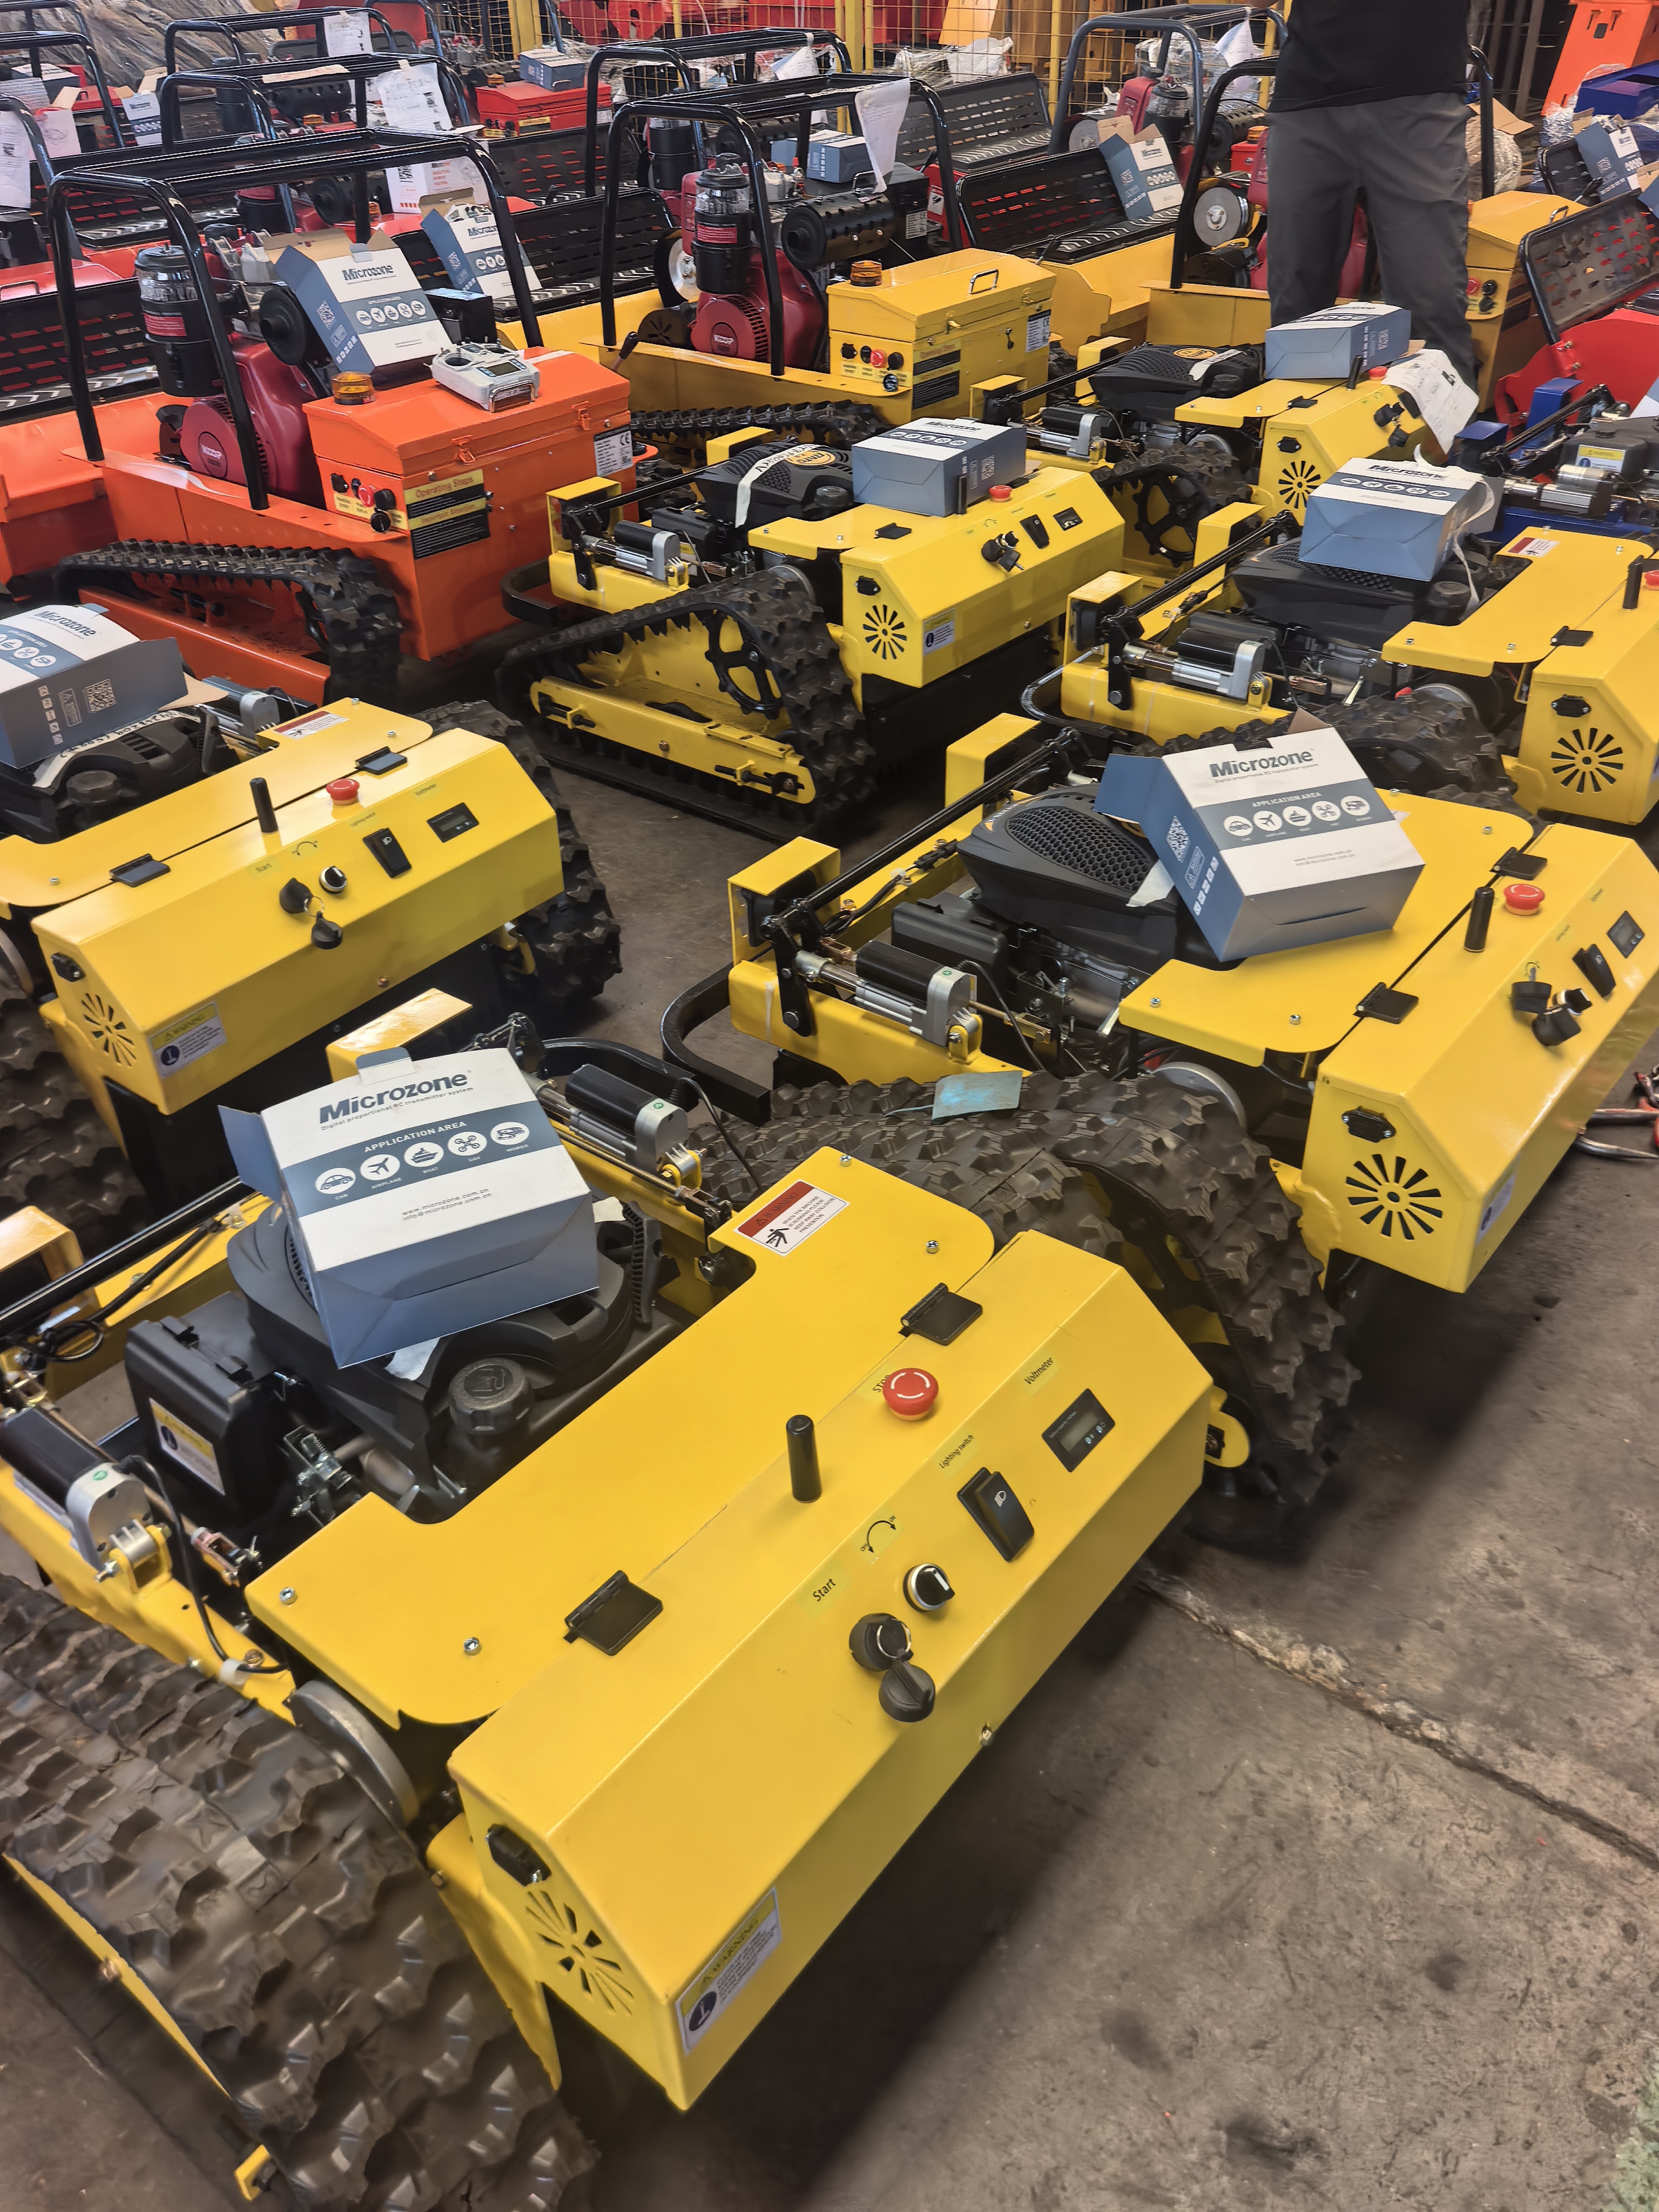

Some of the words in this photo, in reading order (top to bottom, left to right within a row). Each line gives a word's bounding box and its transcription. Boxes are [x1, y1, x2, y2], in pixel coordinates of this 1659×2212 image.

[33, 611, 97, 636] Microzone
[1209, 751, 1313, 777] Microzone
[1252, 795, 1301, 807] APPLICATION
[1300, 792, 1323, 800] AREA
[320, 1074, 468, 1124] Microzone
[321, 1120, 346, 1131] Digital
[347, 1105, 393, 1123] proportional
[404, 1092, 447, 1105] transmitter
[448, 1087, 474, 1096] system
[364, 1128, 436, 1153] APPLICATION
[437, 1121, 468, 1133] AREA
[505, 1144, 530, 1152] MOWER
[371, 1177, 403, 1190] AIRPLANE
[402, 1188, 489, 1216] www.microzone.com.cn
[403, 1193, 493, 1221] info@microzone.com.cn
[1023, 1357, 1054, 1385] Voltmeter
[938, 1448, 961, 1469] Lighting
[958, 1434, 975, 1451] switch
[812, 1578, 837, 1602] Start
